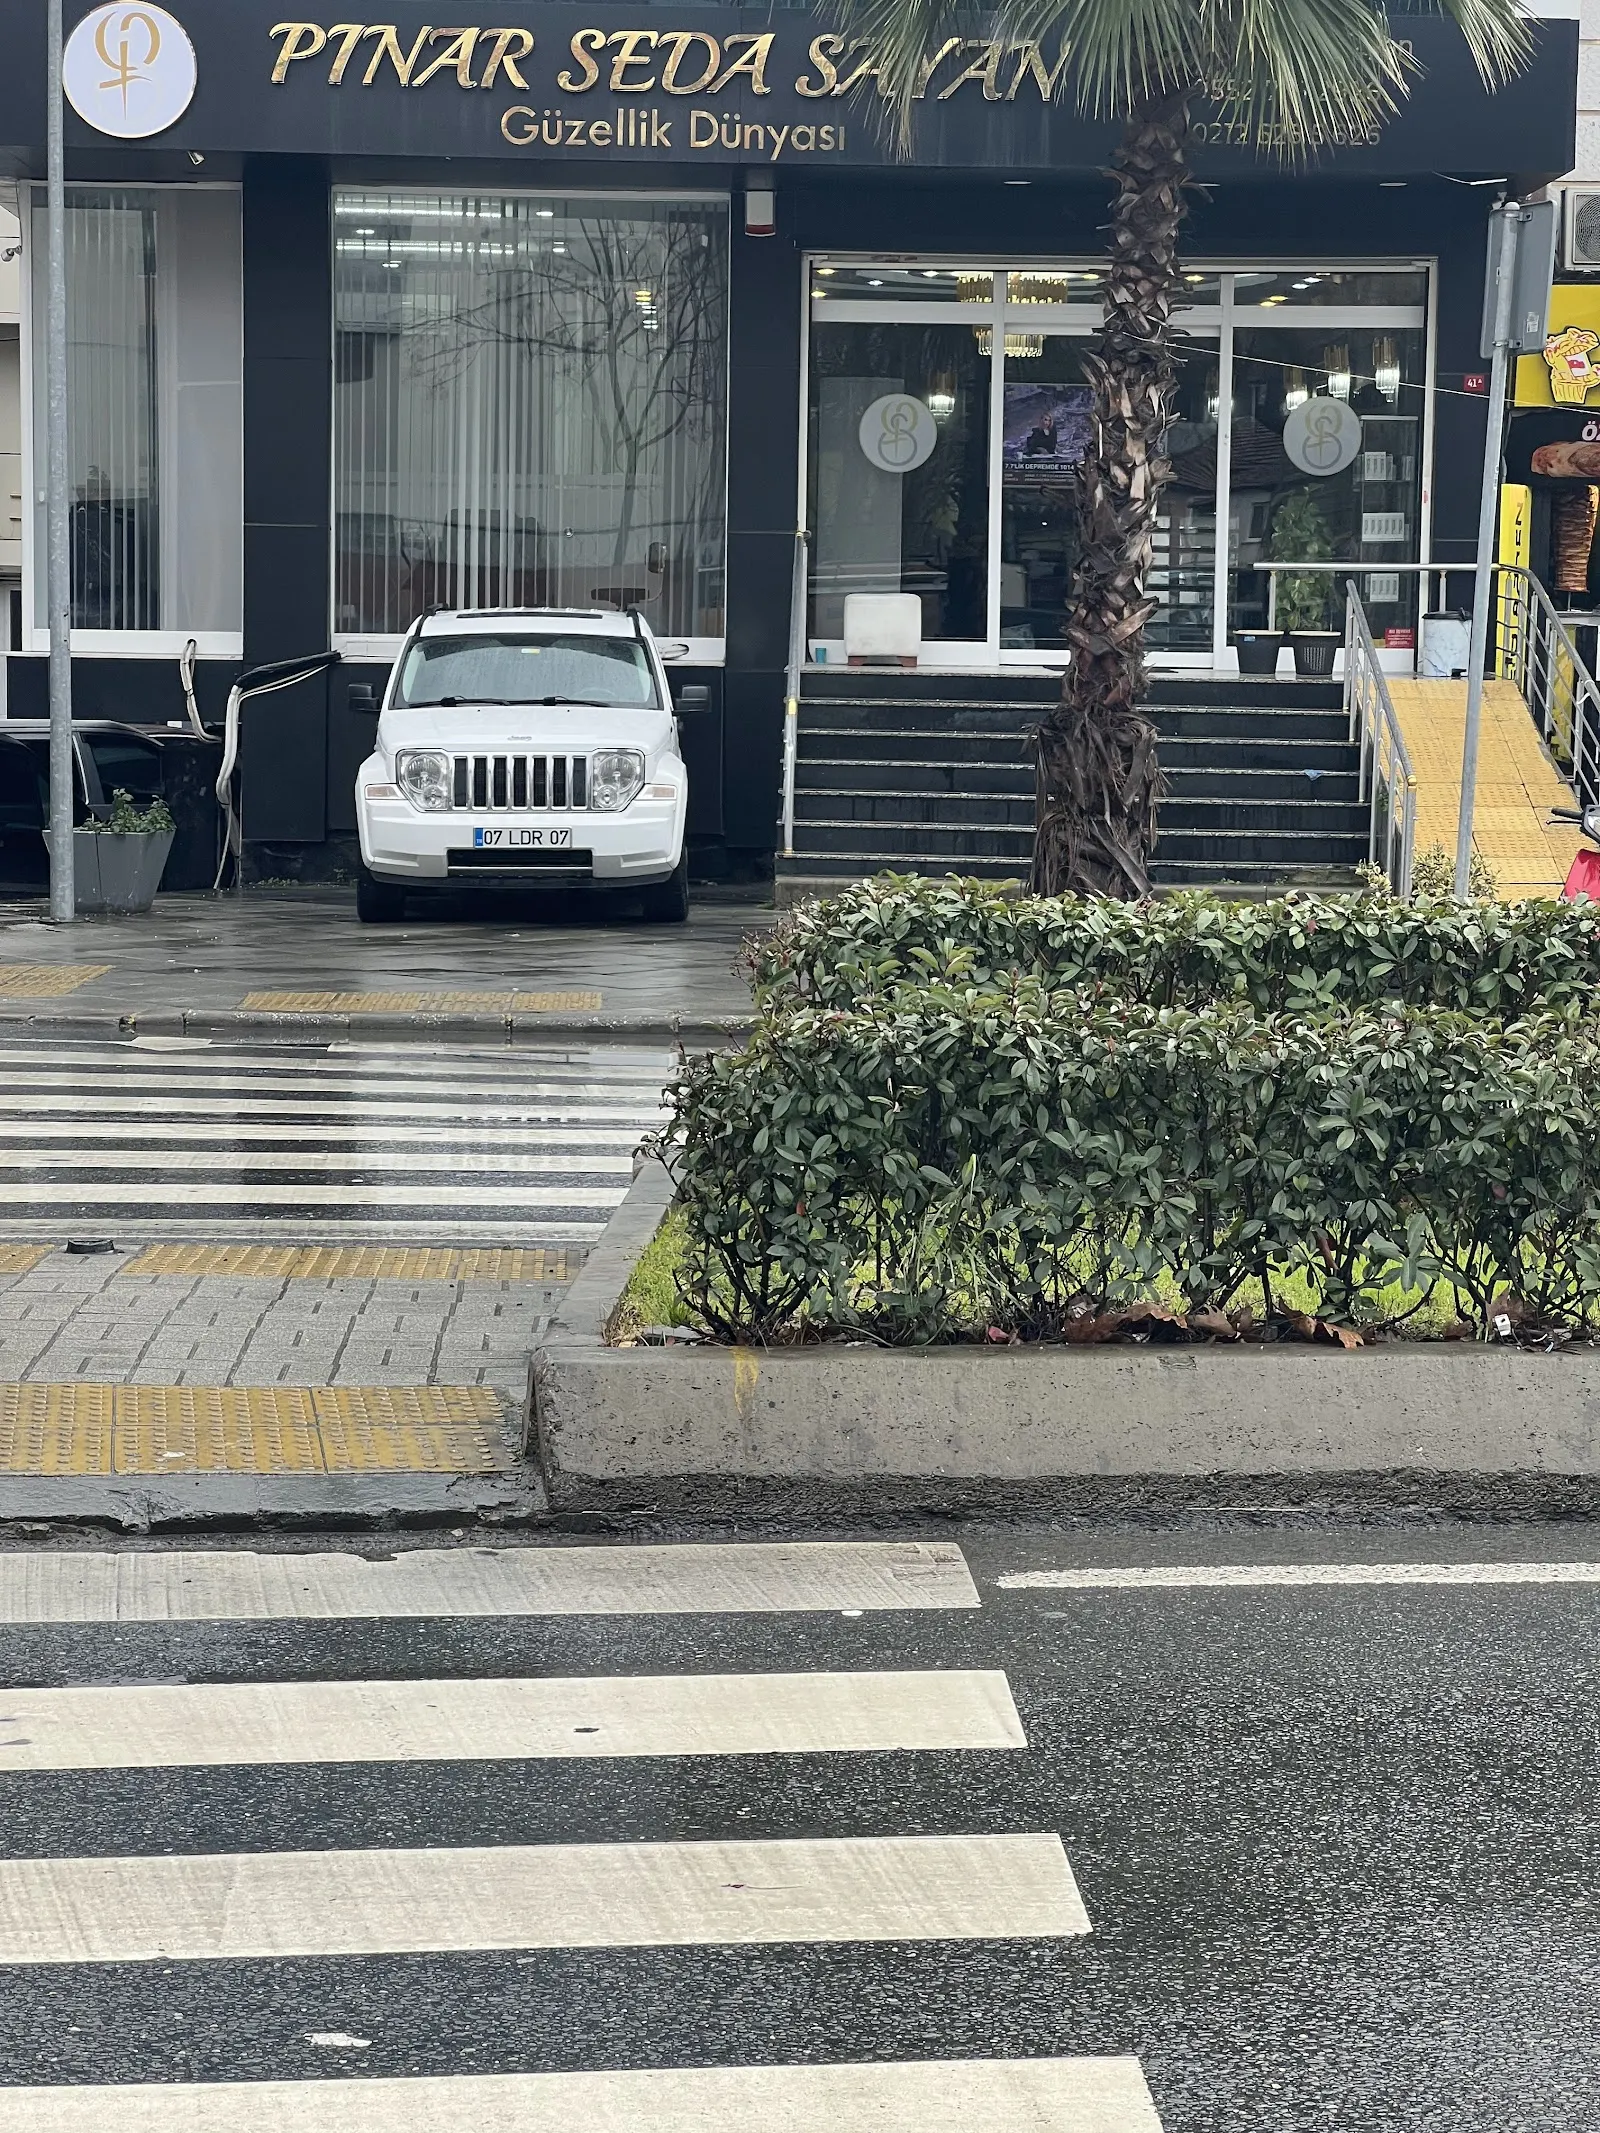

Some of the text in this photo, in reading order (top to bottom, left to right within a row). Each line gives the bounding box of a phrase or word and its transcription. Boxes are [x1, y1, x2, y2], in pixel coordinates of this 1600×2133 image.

[269, 22, 535, 90] PINAR
[557, 28, 776, 96] SEDA
[501, 105, 846, 161] Güzellik Dünyası
[484, 830, 569, 845] 07 LDR 07
